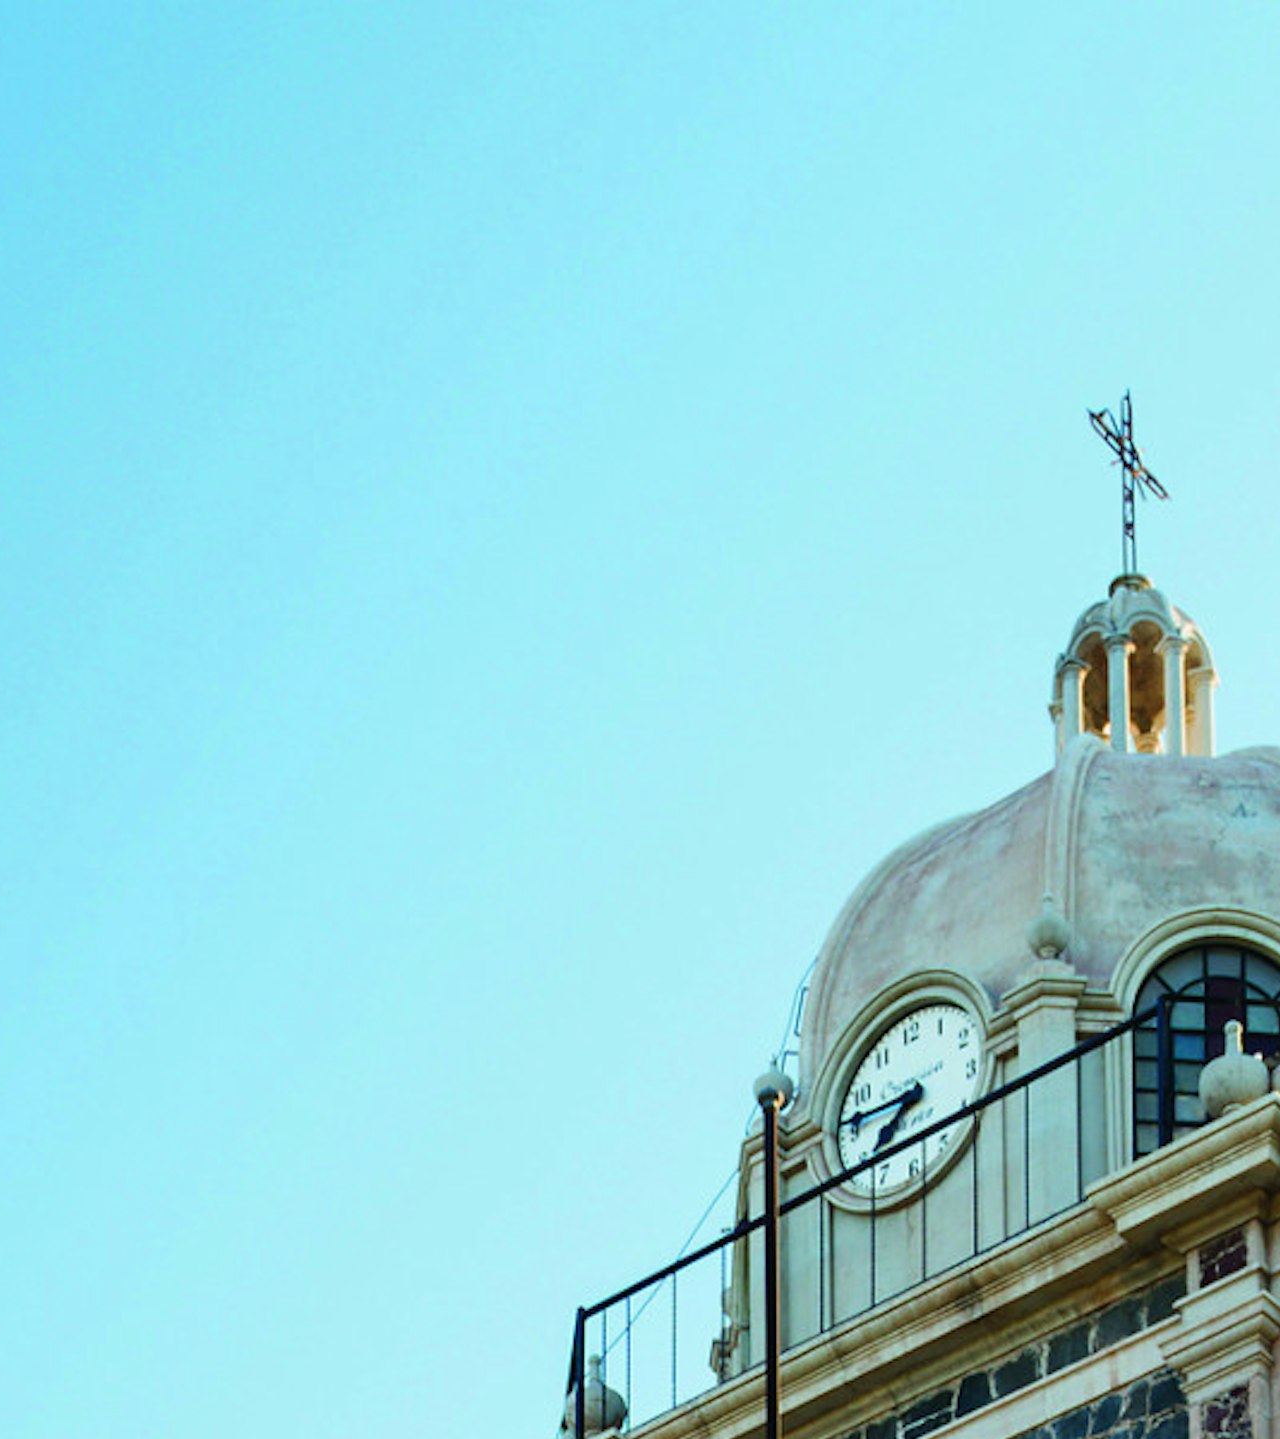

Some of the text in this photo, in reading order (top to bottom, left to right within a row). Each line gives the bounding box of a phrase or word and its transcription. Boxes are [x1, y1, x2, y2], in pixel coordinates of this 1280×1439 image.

[903, 1021, 919, 1046] 12
[959, 1029, 969, 1049] 2
[876, 1048, 889, 1070] 11
[966, 1060, 977, 1079] 3
[854, 1083, 871, 1107] 10
[938, 1134, 949, 1154] 5
[879, 1163, 890, 1186] 7
[909, 1158, 920, 1178] 6
